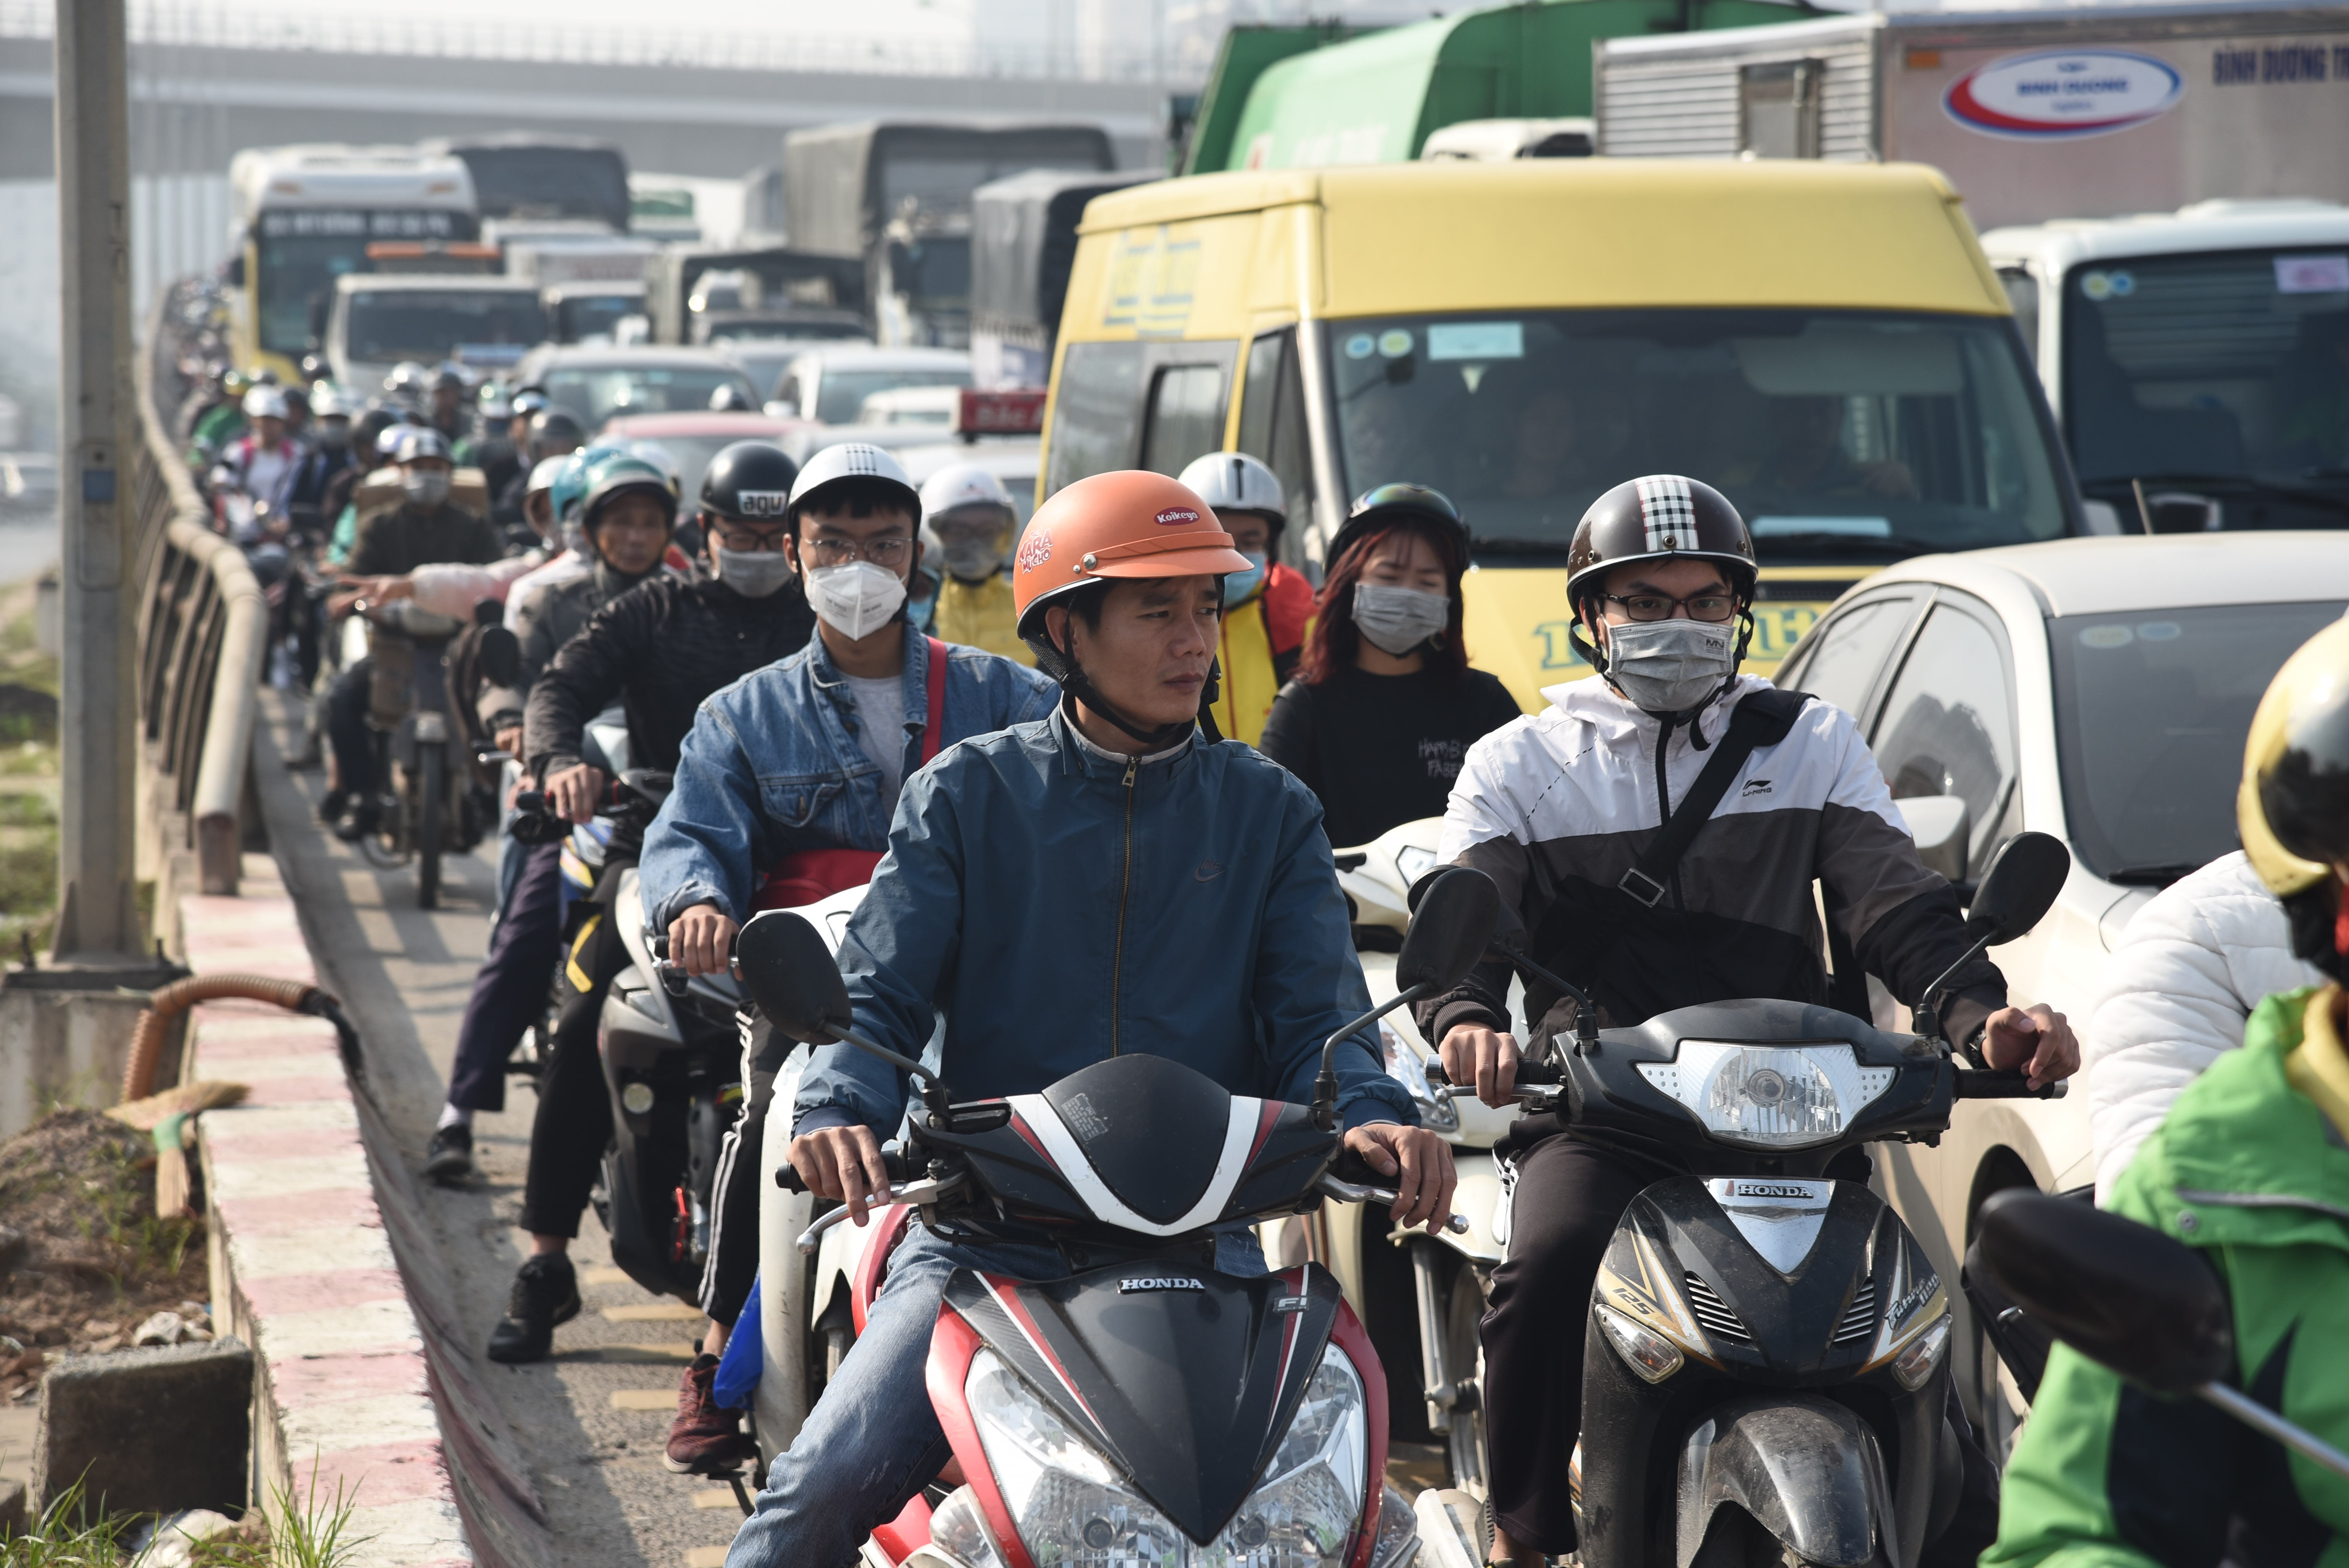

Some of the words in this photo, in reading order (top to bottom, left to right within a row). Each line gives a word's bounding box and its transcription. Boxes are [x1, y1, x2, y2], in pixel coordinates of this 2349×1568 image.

[1157, 511, 1198, 523] Koikeya
[1018, 529, 1053, 566] KARA
[1023, 548, 1051, 574] MUCHO
[1743, 788, 1772, 797] LI-NING
[1201, 859, 1221, 870] NIKE
[1739, 1185, 1814, 1197] HONDA
[1121, 1278, 1205, 1290] HONDA
[1278, 1297, 1307, 1307] FI
[1612, 1288, 1656, 1315] 125
